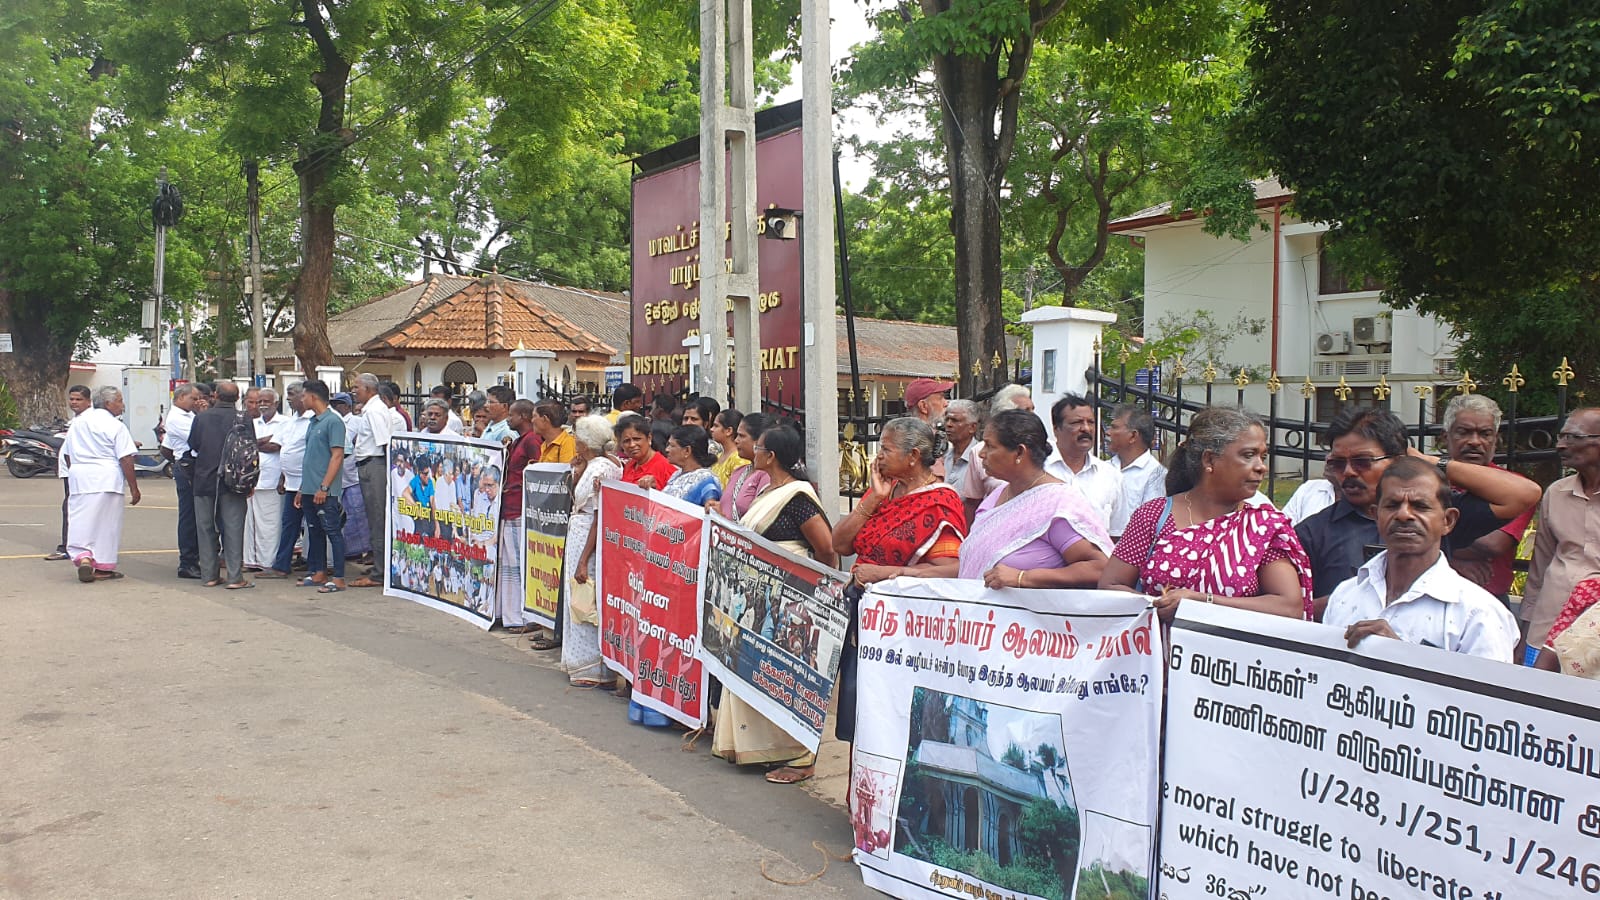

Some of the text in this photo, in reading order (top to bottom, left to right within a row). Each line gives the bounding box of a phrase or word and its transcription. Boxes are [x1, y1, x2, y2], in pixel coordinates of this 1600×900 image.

[633, 354, 689, 375] DISTRICT
[711, 525, 720, 548] 6
[905, 605, 996, 652] செபஸ்தியார்
[1002, 620, 1079, 659] ஆலயம்
[859, 645, 883, 661] 1999
[885, 648, 903, 665] இல்
[978, 664, 1013, 690] இருந்த
[1017, 672, 1056, 692] ஆலயம்
[1327, 683, 1415, 729] ஆகியும்
[1193, 697, 1327, 751] காணிகளை
[1337, 730, 1565, 825] விடுவிப்பதற்கான
[1301, 768, 1387, 826] (J/248,
[1396, 802, 1492, 862] J/251,
[1174, 785, 1235, 820] moral
[1241, 806, 1332, 852] struggle
[1340, 836, 1361, 863] to
[1377, 848, 1473, 900] liberate
[1179, 824, 1239, 859] which
[1248, 841, 1298, 879] have
[1307, 866, 1343, 896] not
